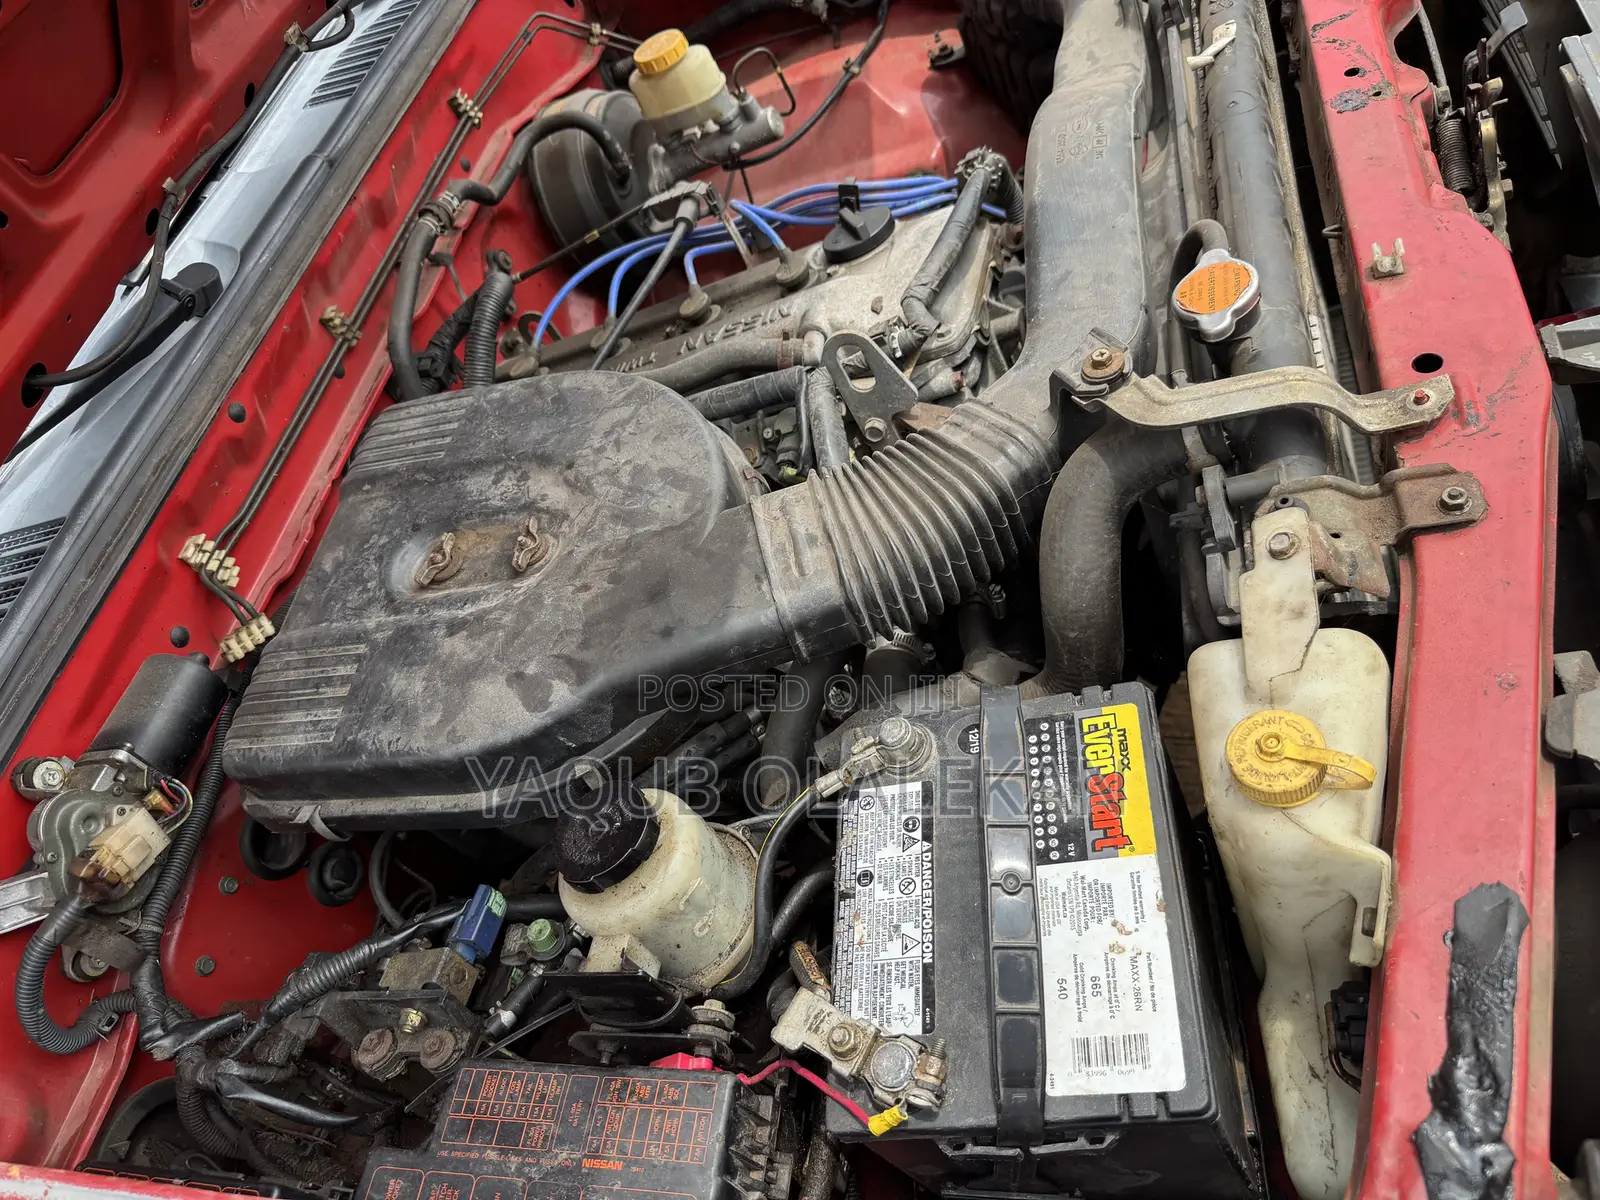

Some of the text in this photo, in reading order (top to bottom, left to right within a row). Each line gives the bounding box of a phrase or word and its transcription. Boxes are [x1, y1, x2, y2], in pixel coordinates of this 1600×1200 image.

[969, 728, 979, 753] 12/19
[1116, 728, 1131, 772] maxx
[921, 852, 933, 963] DANGER/POISON
[1057, 978, 1068, 1000] 540
[1090, 976, 1102, 997] 665
[1130, 956, 1143, 1011] MAXX-26RN
[582, 1158, 624, 1171] NISSAN
